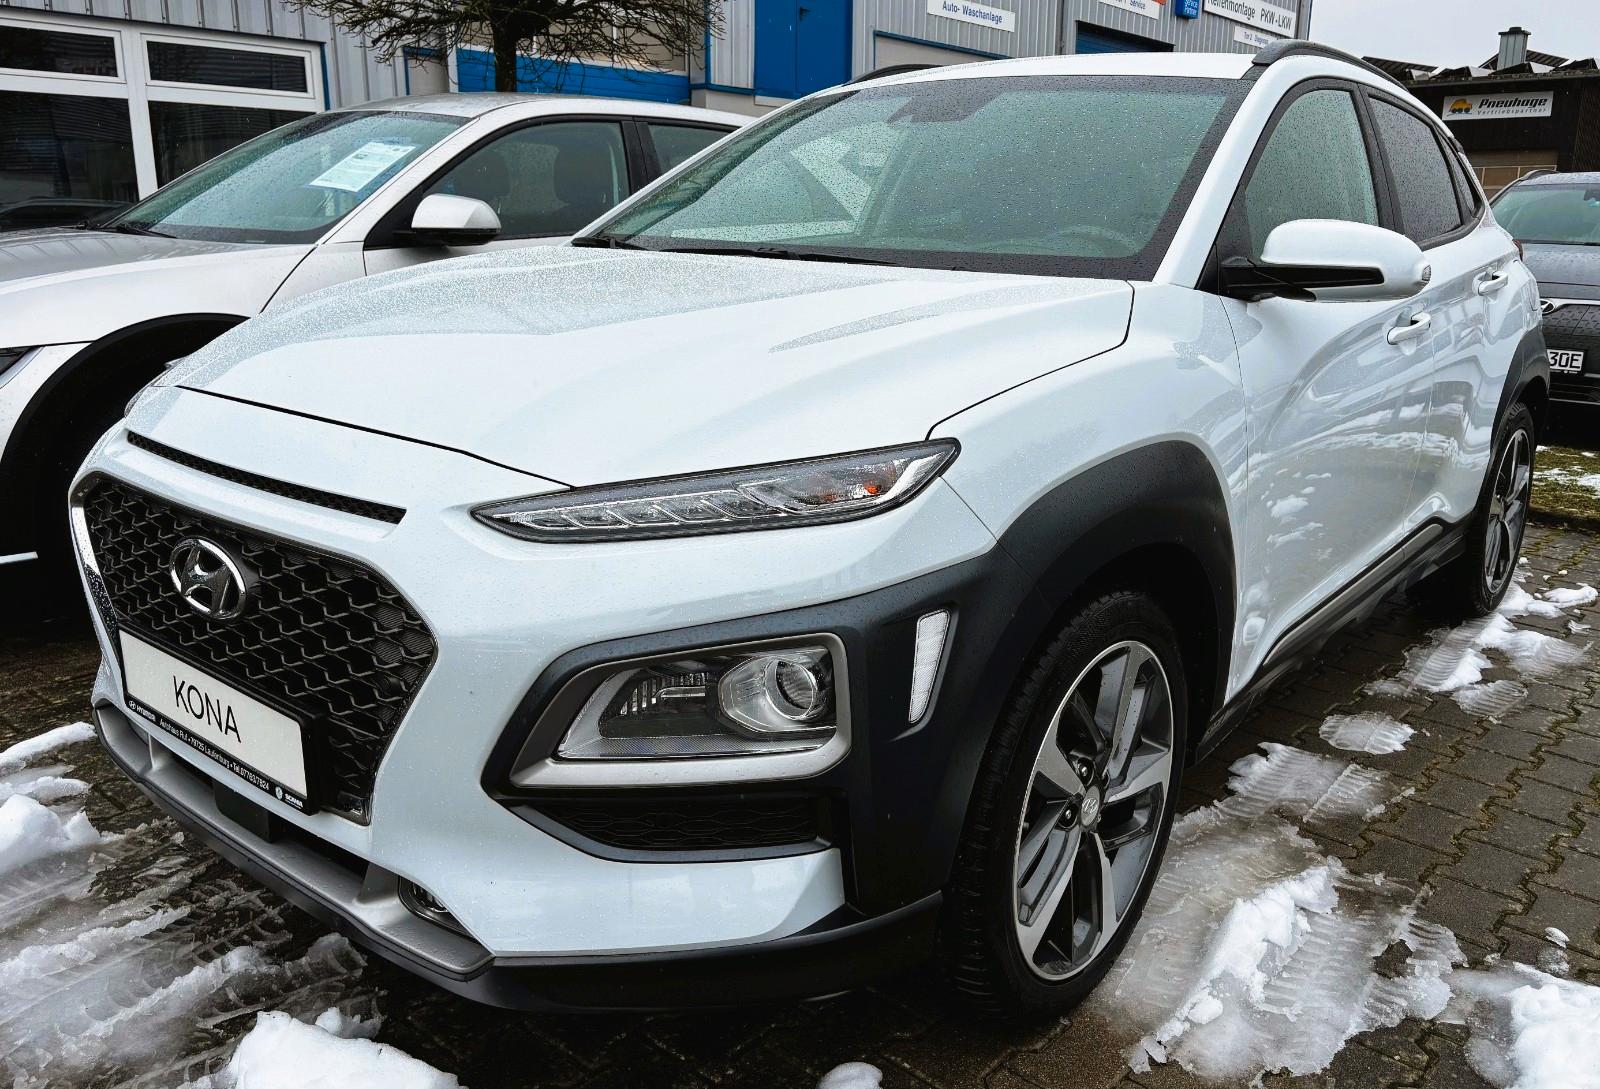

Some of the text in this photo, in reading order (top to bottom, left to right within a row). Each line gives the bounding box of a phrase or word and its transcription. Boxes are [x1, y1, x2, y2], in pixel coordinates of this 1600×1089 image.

[942, 1, 1003, 24] Auto- Waschanlage
[1477, 108, 1546, 116] Vertriebspartner
[1478, 97, 1548, 109] Pneuhage
[173, 675, 242, 744] KONA
[160, 718, 180, 737] Autohaus
